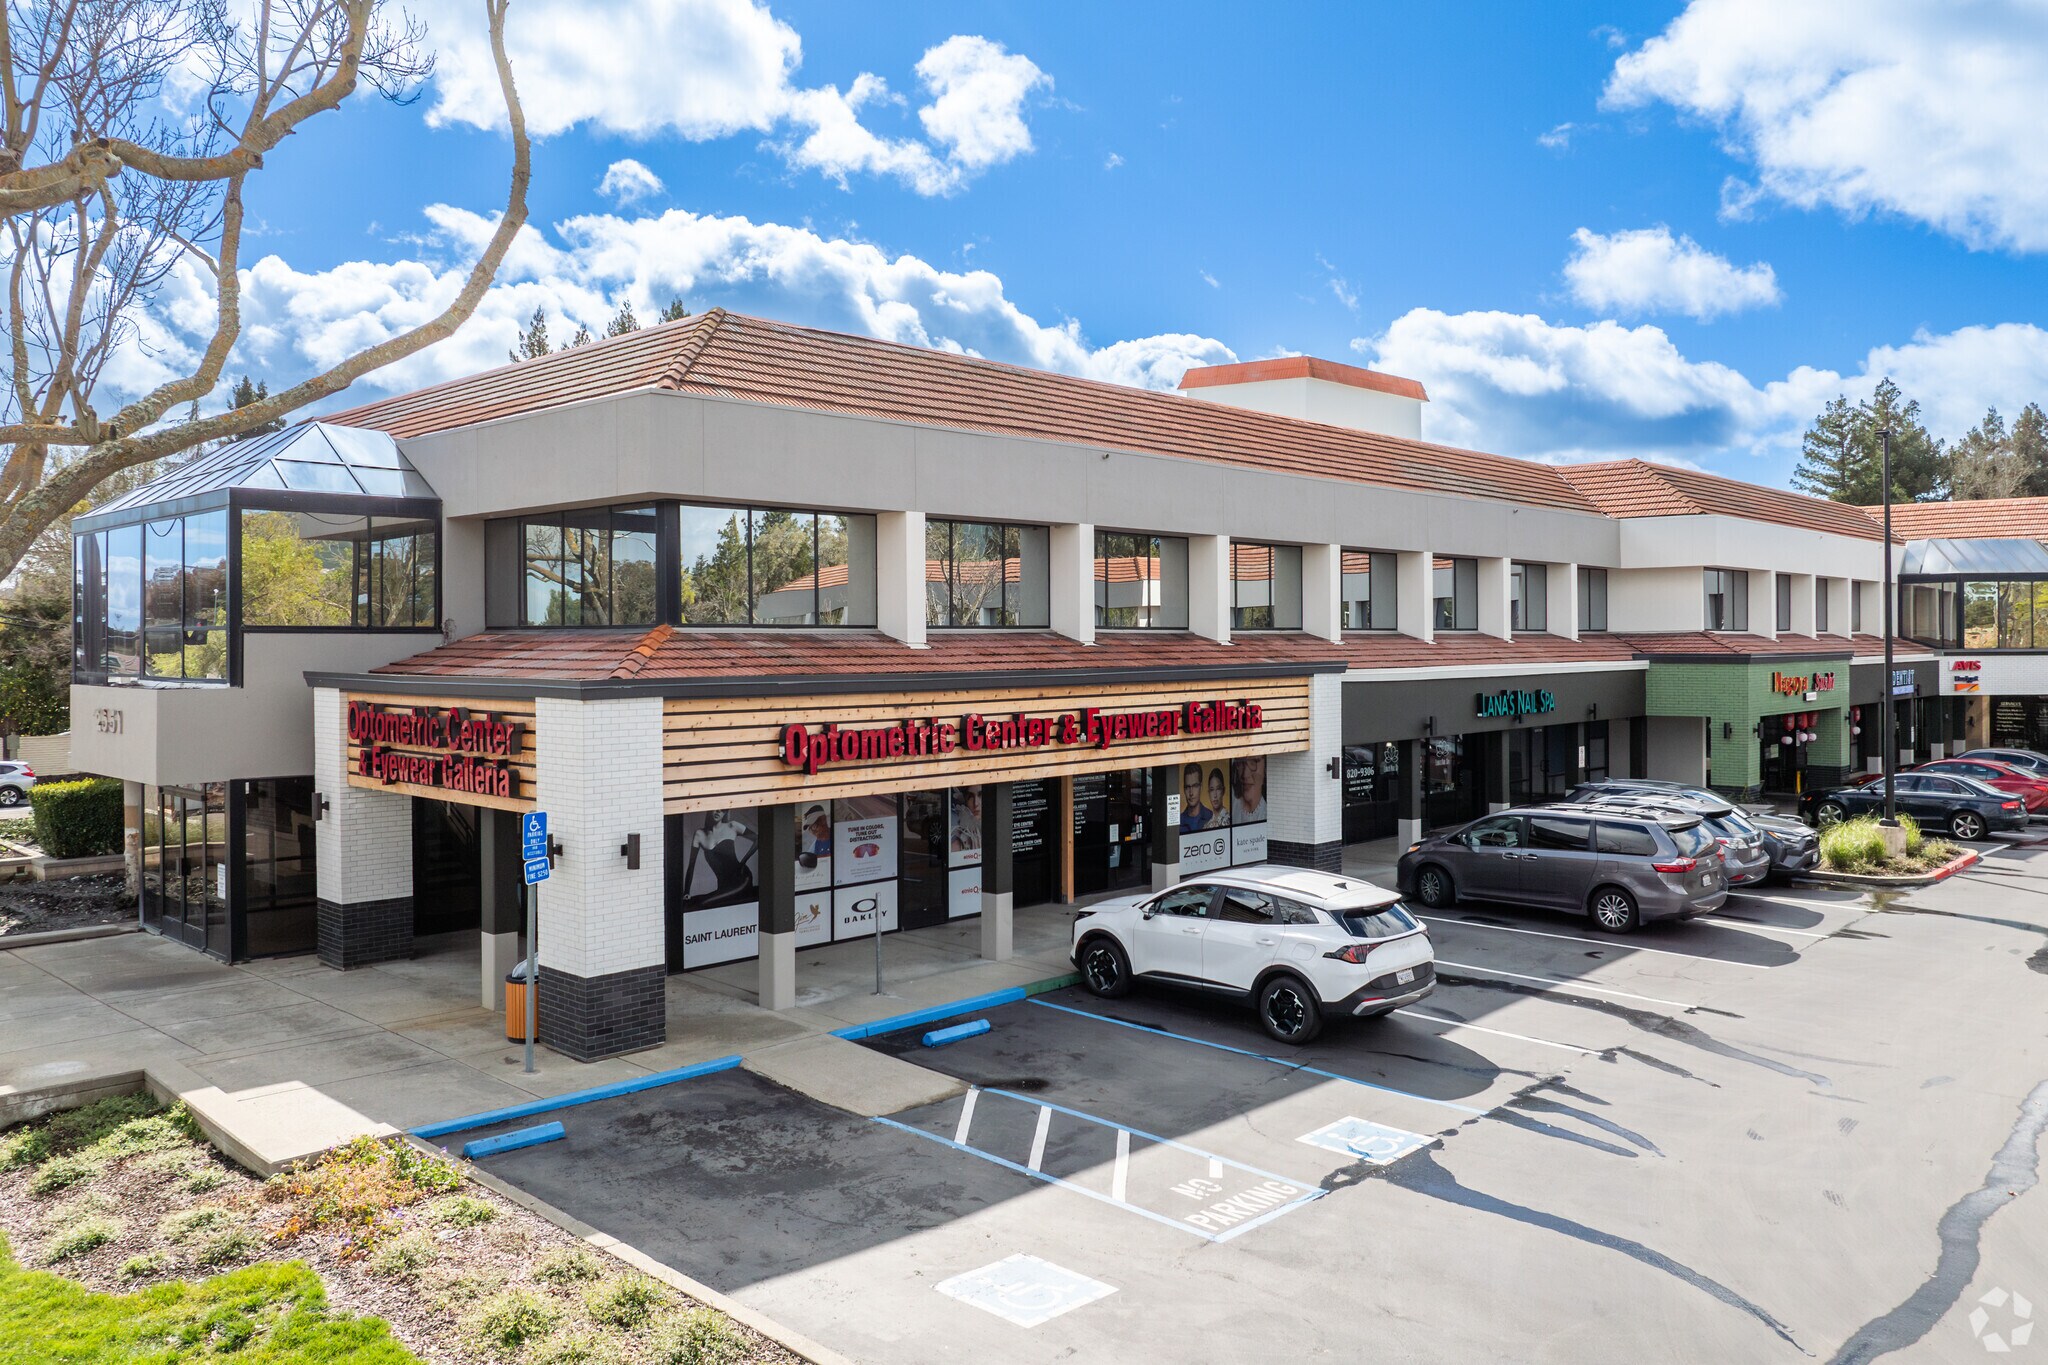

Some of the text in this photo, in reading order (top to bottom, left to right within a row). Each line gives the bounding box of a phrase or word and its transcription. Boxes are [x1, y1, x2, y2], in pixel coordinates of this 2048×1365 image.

[1952, 660, 1982, 671] AVIS
[1774, 671, 1835, 696] Nagoya Sushi
[1954, 675, 1979, 683] Budget
[1482, 688, 1556, 717] LANA'S NAIL SPA
[348, 700, 516, 756] Optometric Center
[784, 698, 1263, 775] Optometric Center & Eyewear Galleria
[358, 746, 510, 798] & Eyewear Galleria
[1183, 842, 1212, 859] zero
[1236, 834, 1265, 846] kate spade
[527, 872, 536, 880] FINE
[844, 910, 888, 924] OAKLY
[684, 924, 757, 945] SAINT LAURENT
[1169, 1178, 1223, 1201] NO
[1183, 1180, 1298, 1231] PARKING
